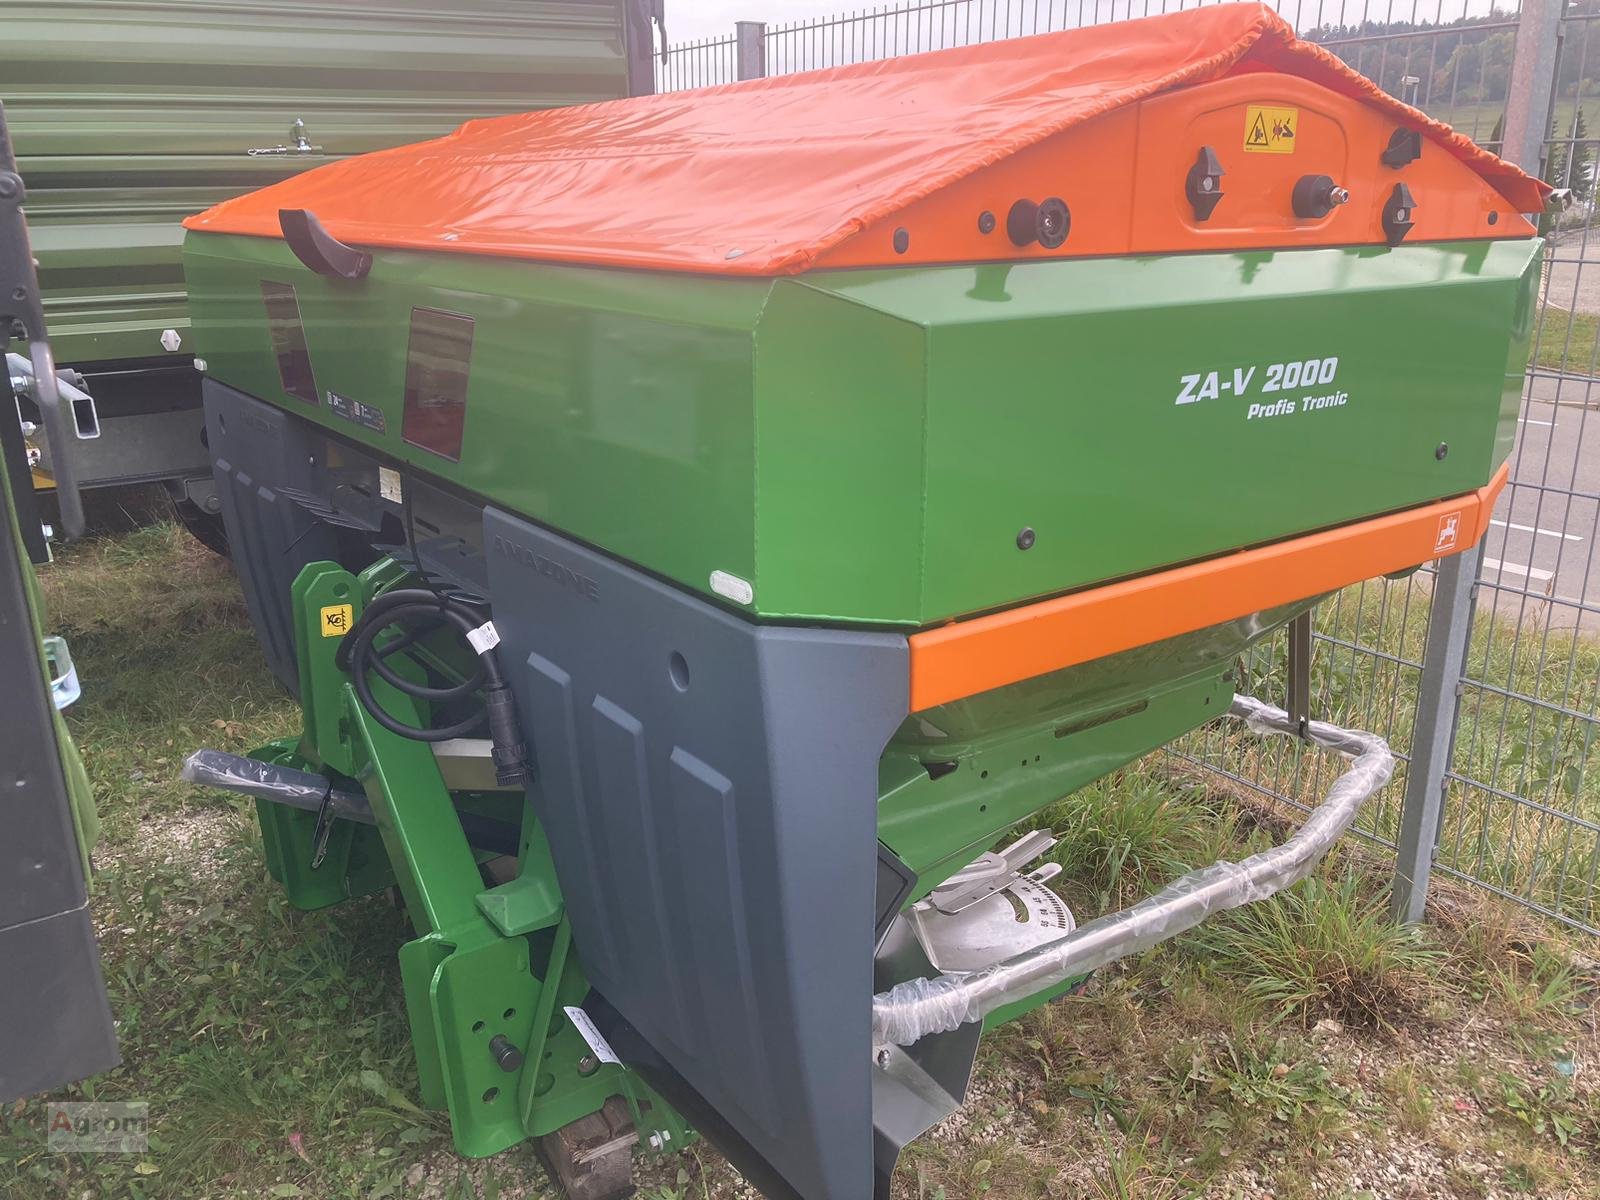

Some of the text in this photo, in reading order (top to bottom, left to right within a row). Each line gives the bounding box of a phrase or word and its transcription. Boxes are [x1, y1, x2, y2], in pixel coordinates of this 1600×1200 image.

[1175, 357, 1338, 405] ZA-V 2000
[1247, 390, 1348, 420] Profis Tronic
[495, 533, 601, 602] AMAZONE
